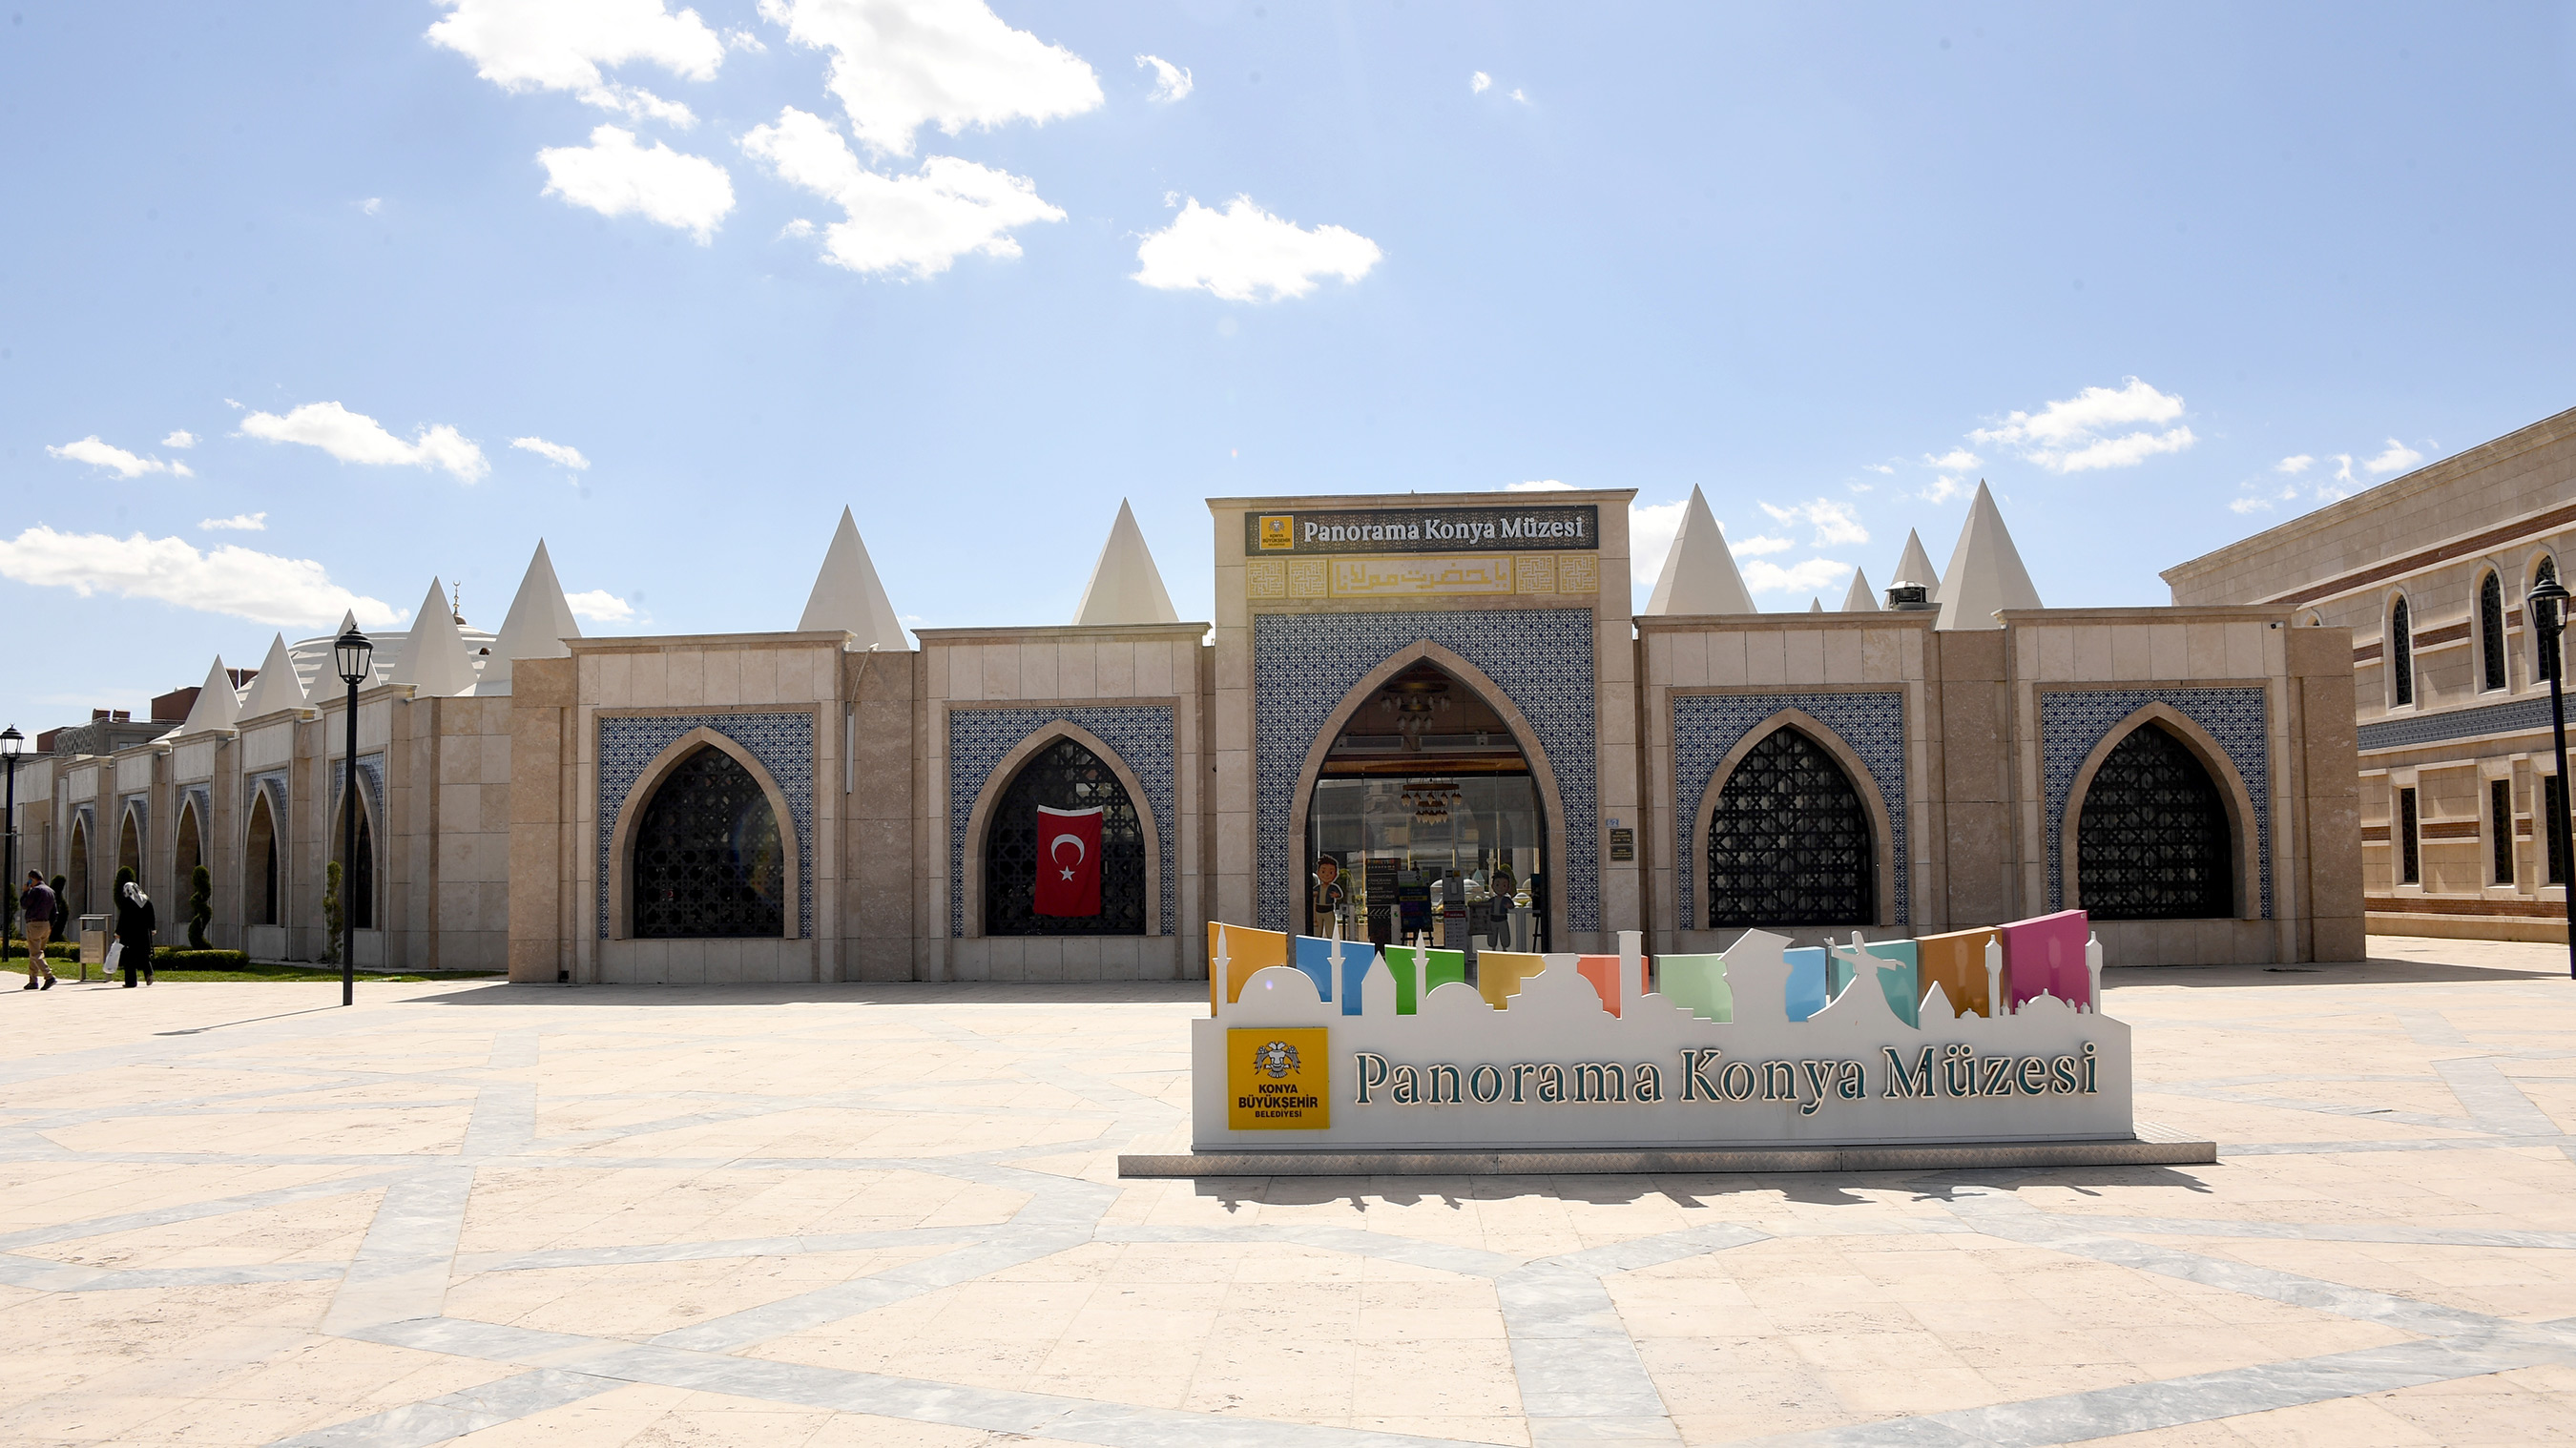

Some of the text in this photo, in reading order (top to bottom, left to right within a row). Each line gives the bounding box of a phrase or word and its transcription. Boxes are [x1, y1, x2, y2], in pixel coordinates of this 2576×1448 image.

[1304, 516, 1584, 545] Panorama Konya Müzesi
[1354, 1041, 2099, 1117] Panorama Konya Müzesi
[1258, 1084, 1298, 1094] KONYA
[1238, 1094, 1319, 1109] BÜYÜKŞEHİR
[1255, 1108, 1302, 1118] BELEDİYESİ
